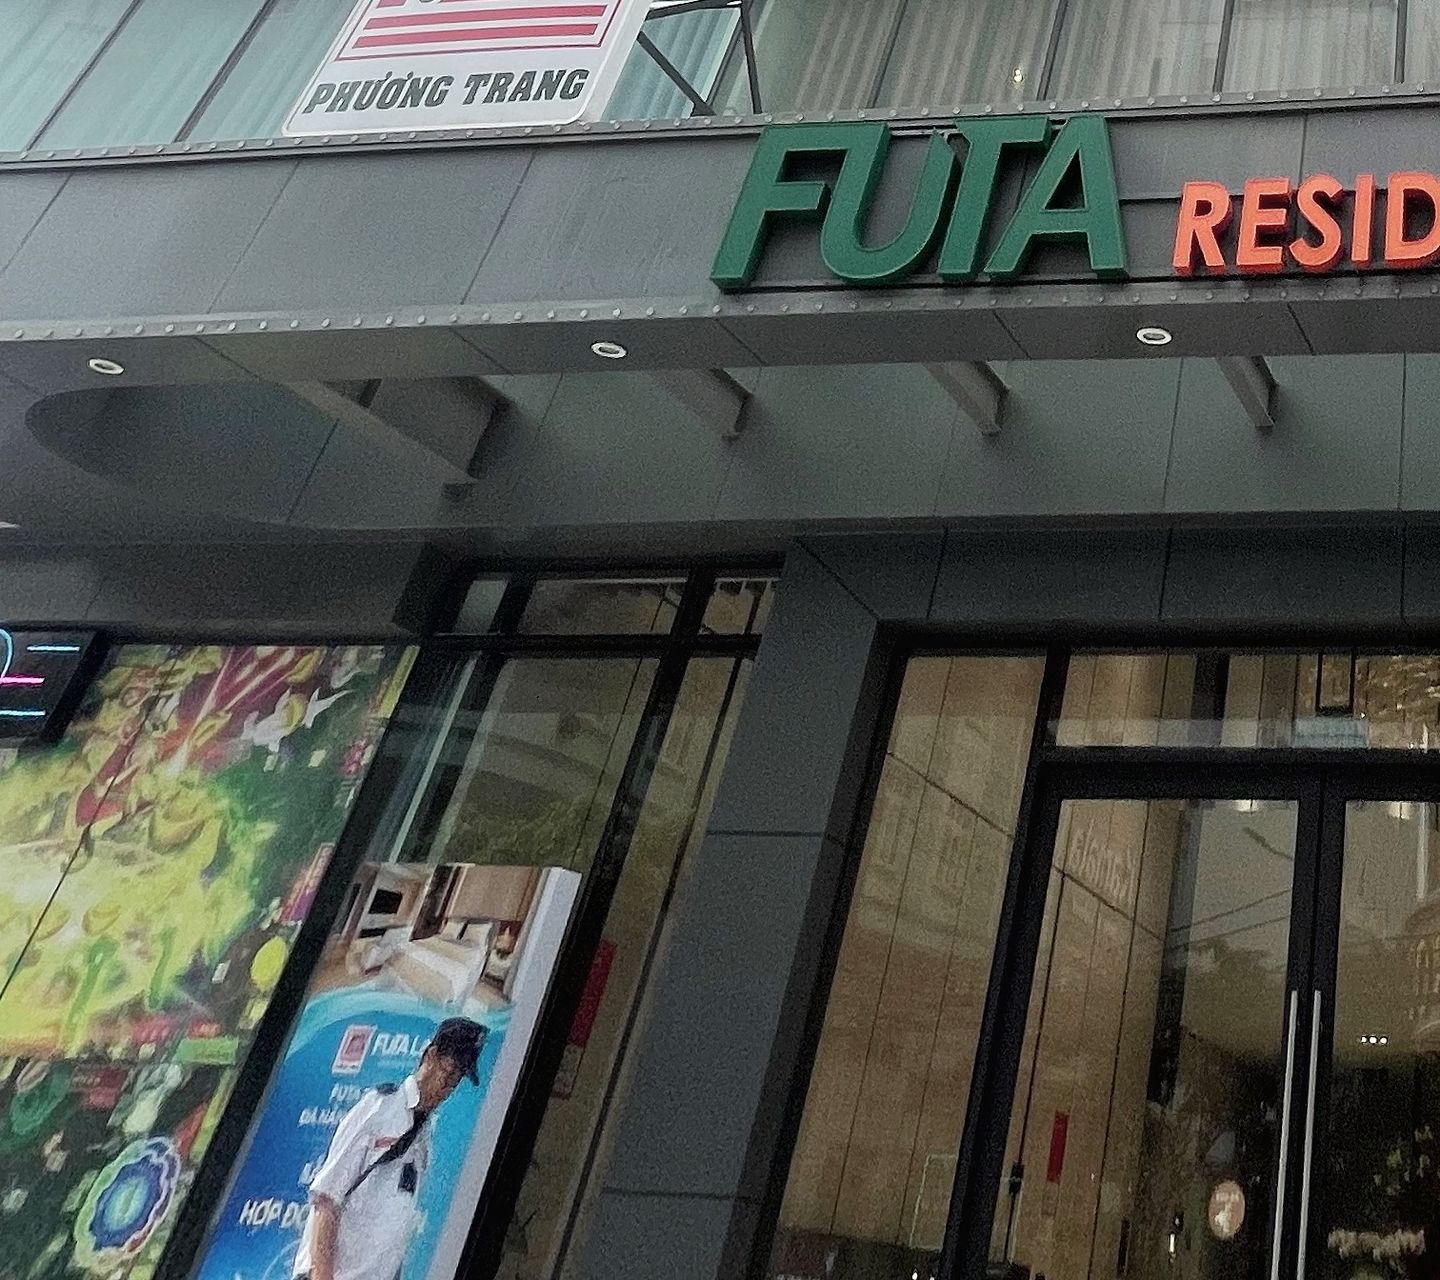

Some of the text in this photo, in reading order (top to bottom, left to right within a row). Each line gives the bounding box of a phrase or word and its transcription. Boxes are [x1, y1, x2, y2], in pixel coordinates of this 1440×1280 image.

[303, 68, 591, 114] PHƯƠNG TRANG
[710, 114, 1129, 293] FUTA
